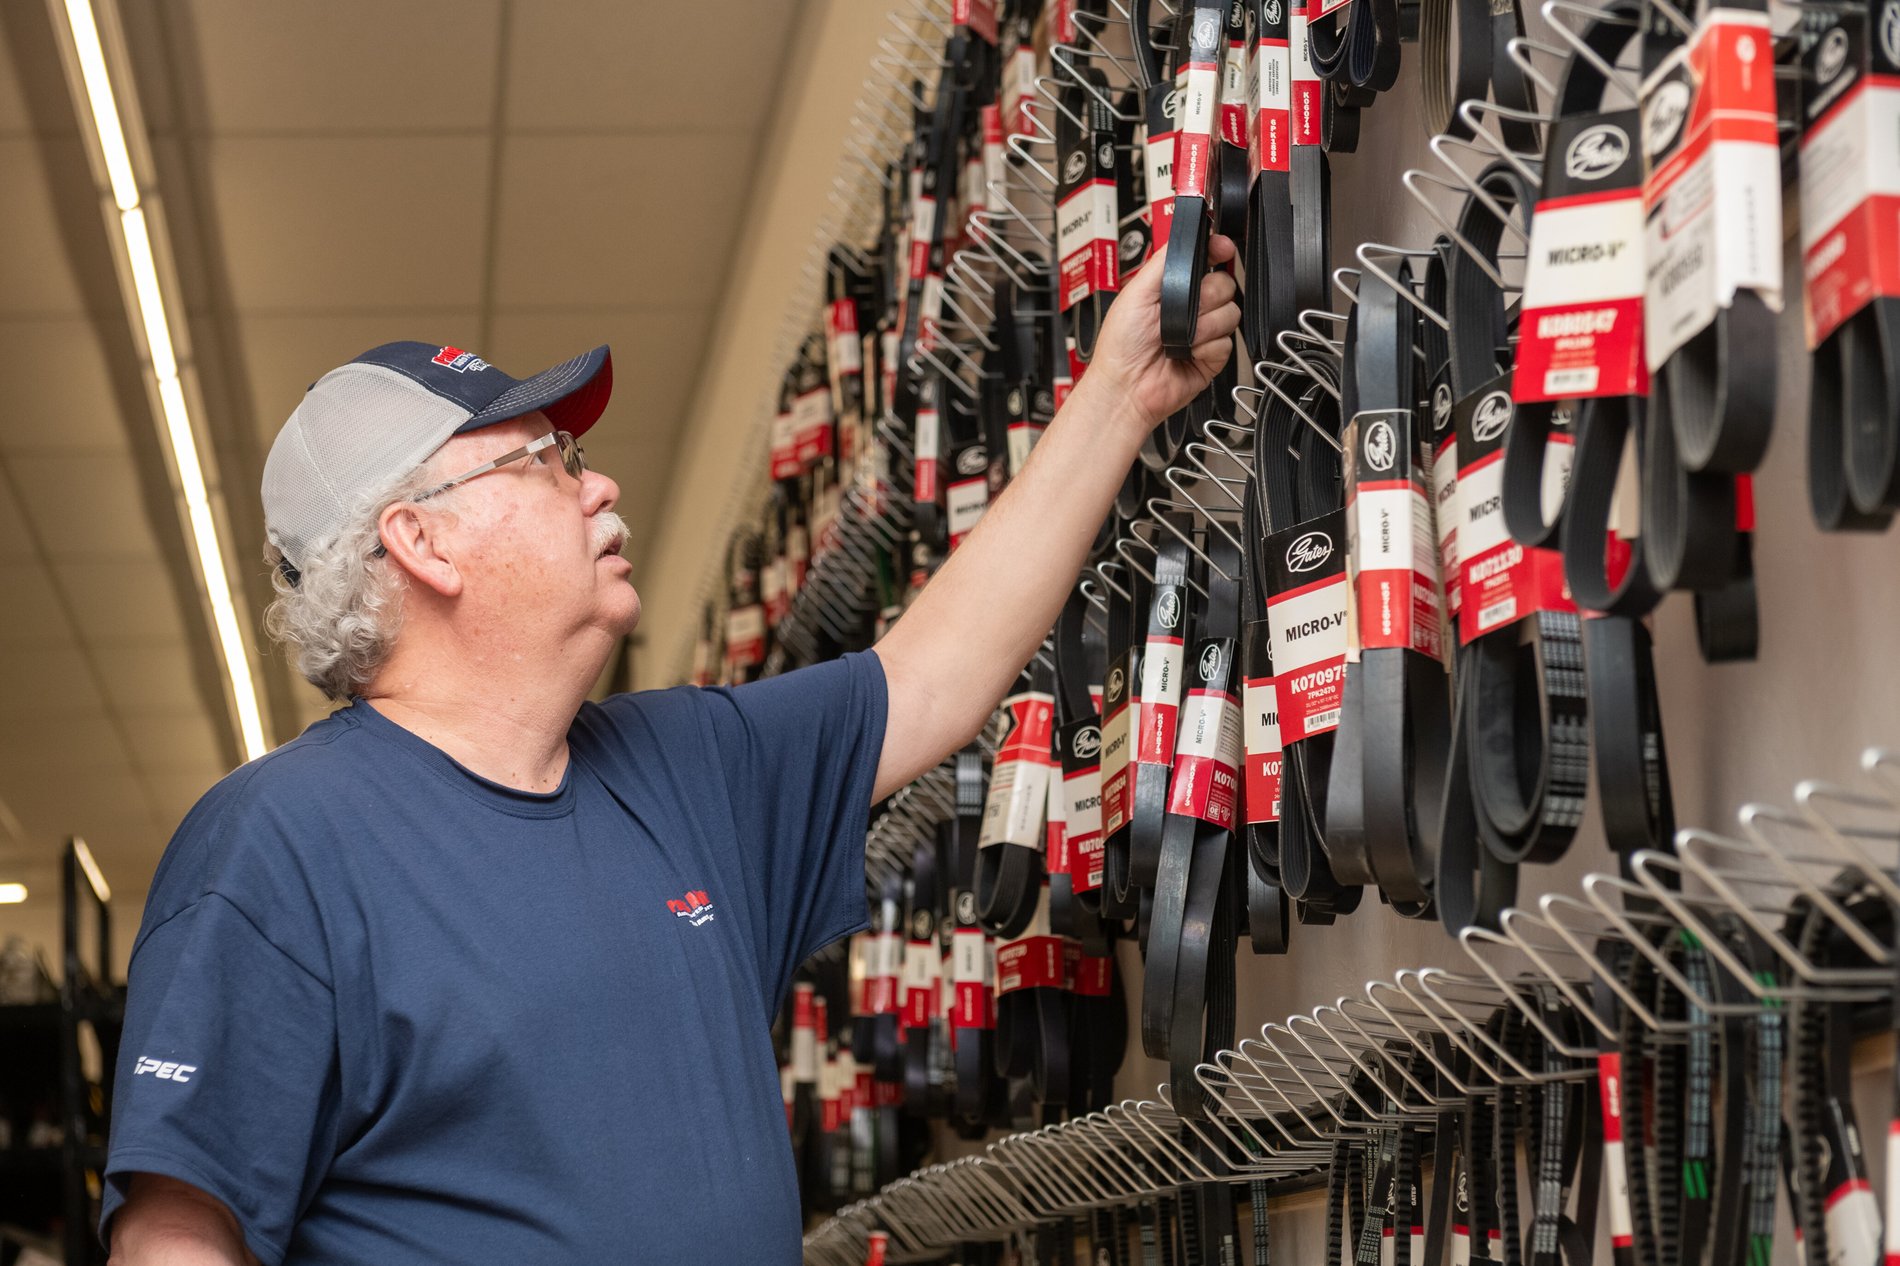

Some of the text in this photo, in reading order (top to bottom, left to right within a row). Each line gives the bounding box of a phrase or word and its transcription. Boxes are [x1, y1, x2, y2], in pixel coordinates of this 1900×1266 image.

[1469, 496, 1500, 522] MICR
[1286, 531, 1334, 573] Gates
[1161, 658, 1170, 692] MICRO-V
[1291, 664, 1348, 695] K070975
[1307, 685, 1336, 700] 7PK2470
